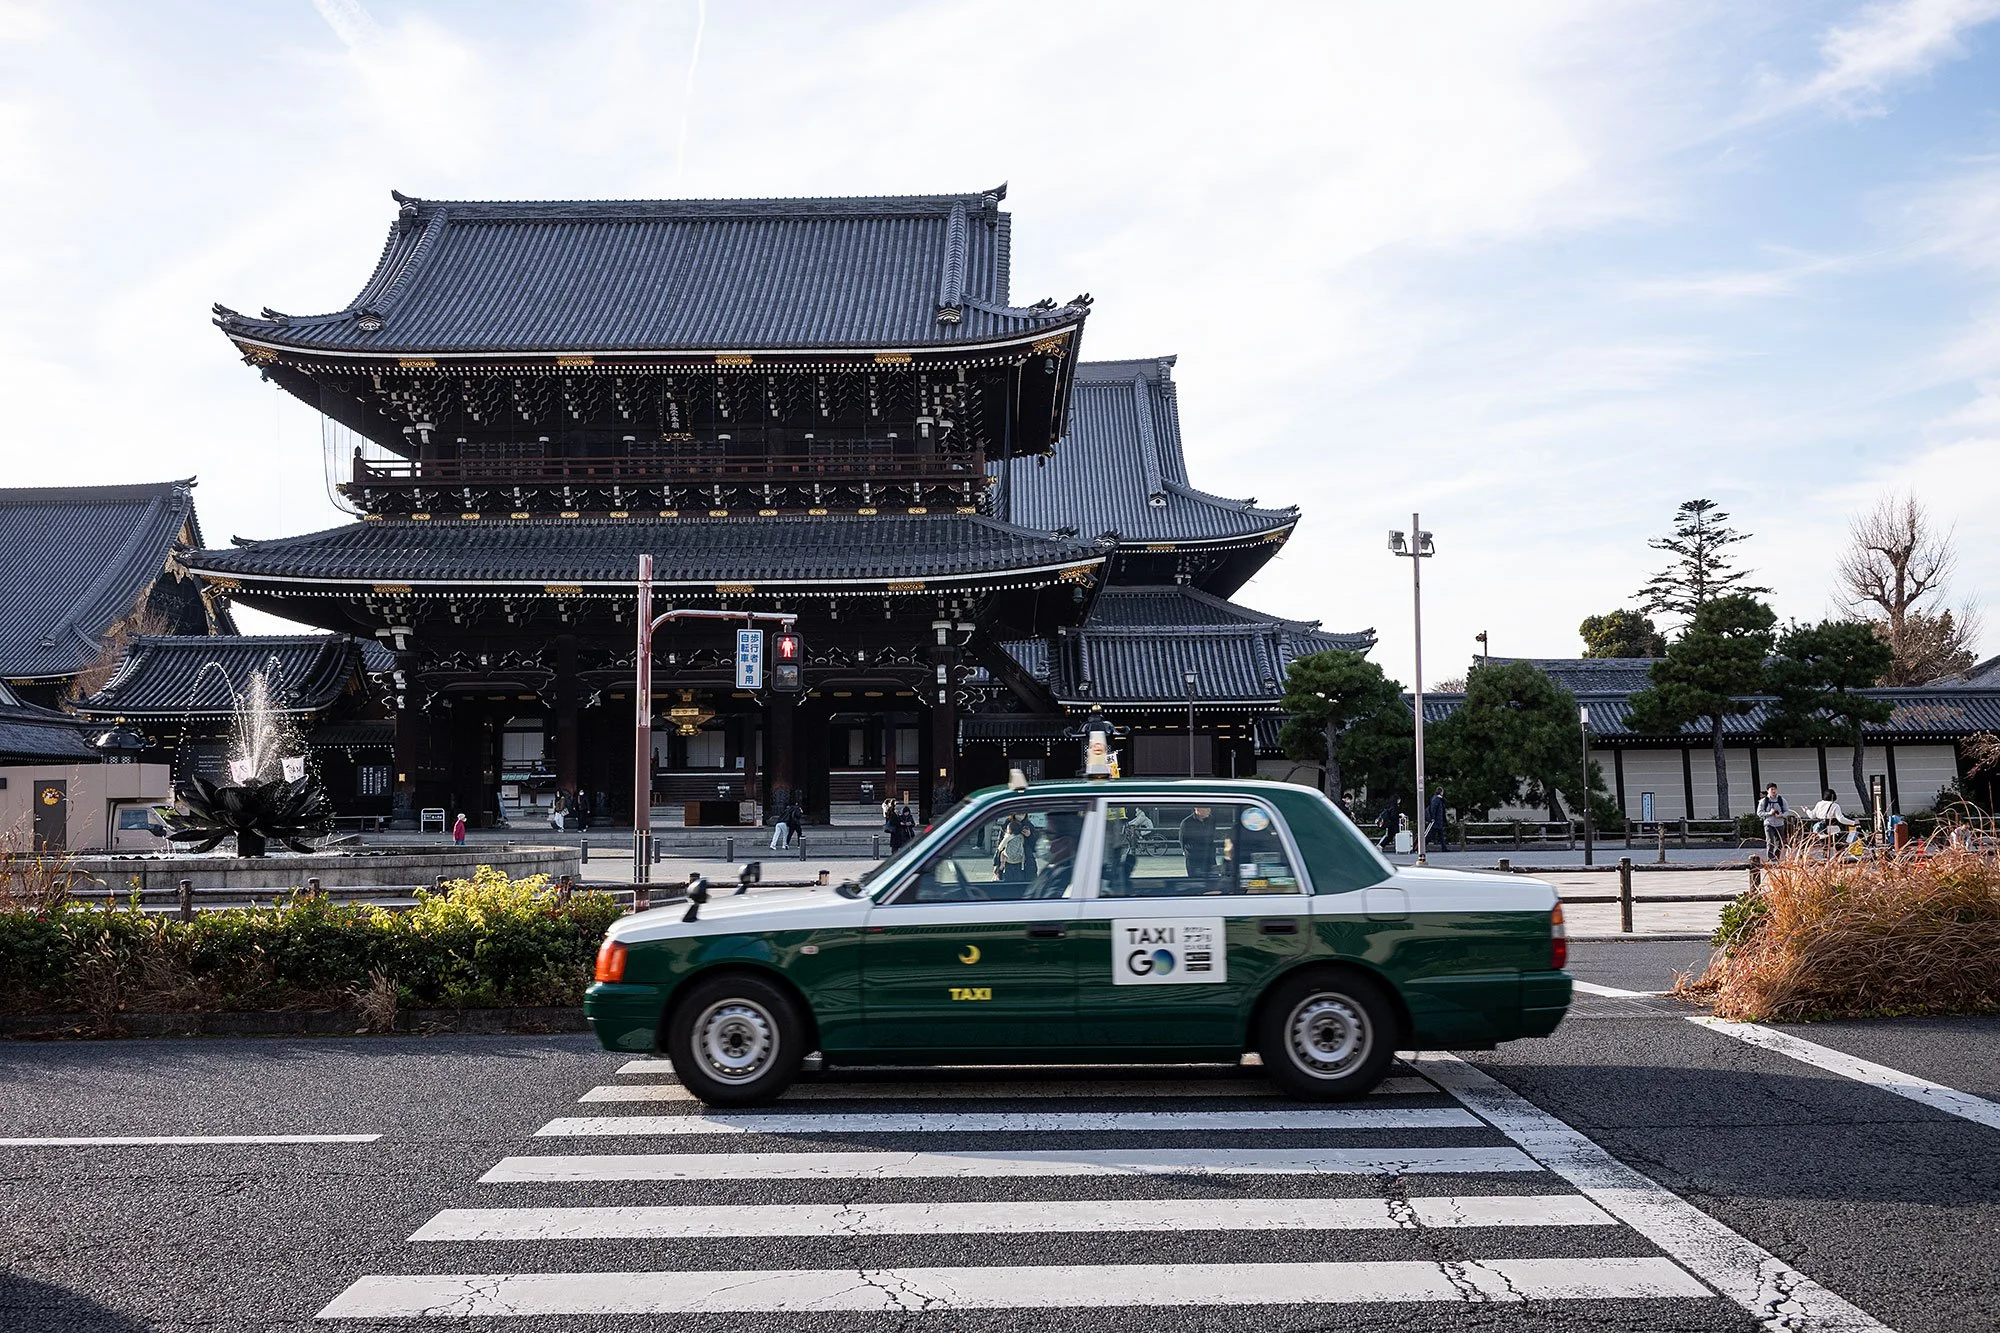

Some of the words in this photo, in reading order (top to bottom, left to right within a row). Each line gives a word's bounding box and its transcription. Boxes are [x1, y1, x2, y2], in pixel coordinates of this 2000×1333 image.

[741, 633, 749, 663] 自転車
[750, 633, 759, 663] 歩行者
[745, 664, 754, 685] 専用
[1126, 927, 1175, 944] TAXI
[1128, 949, 1176, 976] GO
[948, 988, 992, 1000] TAXI
